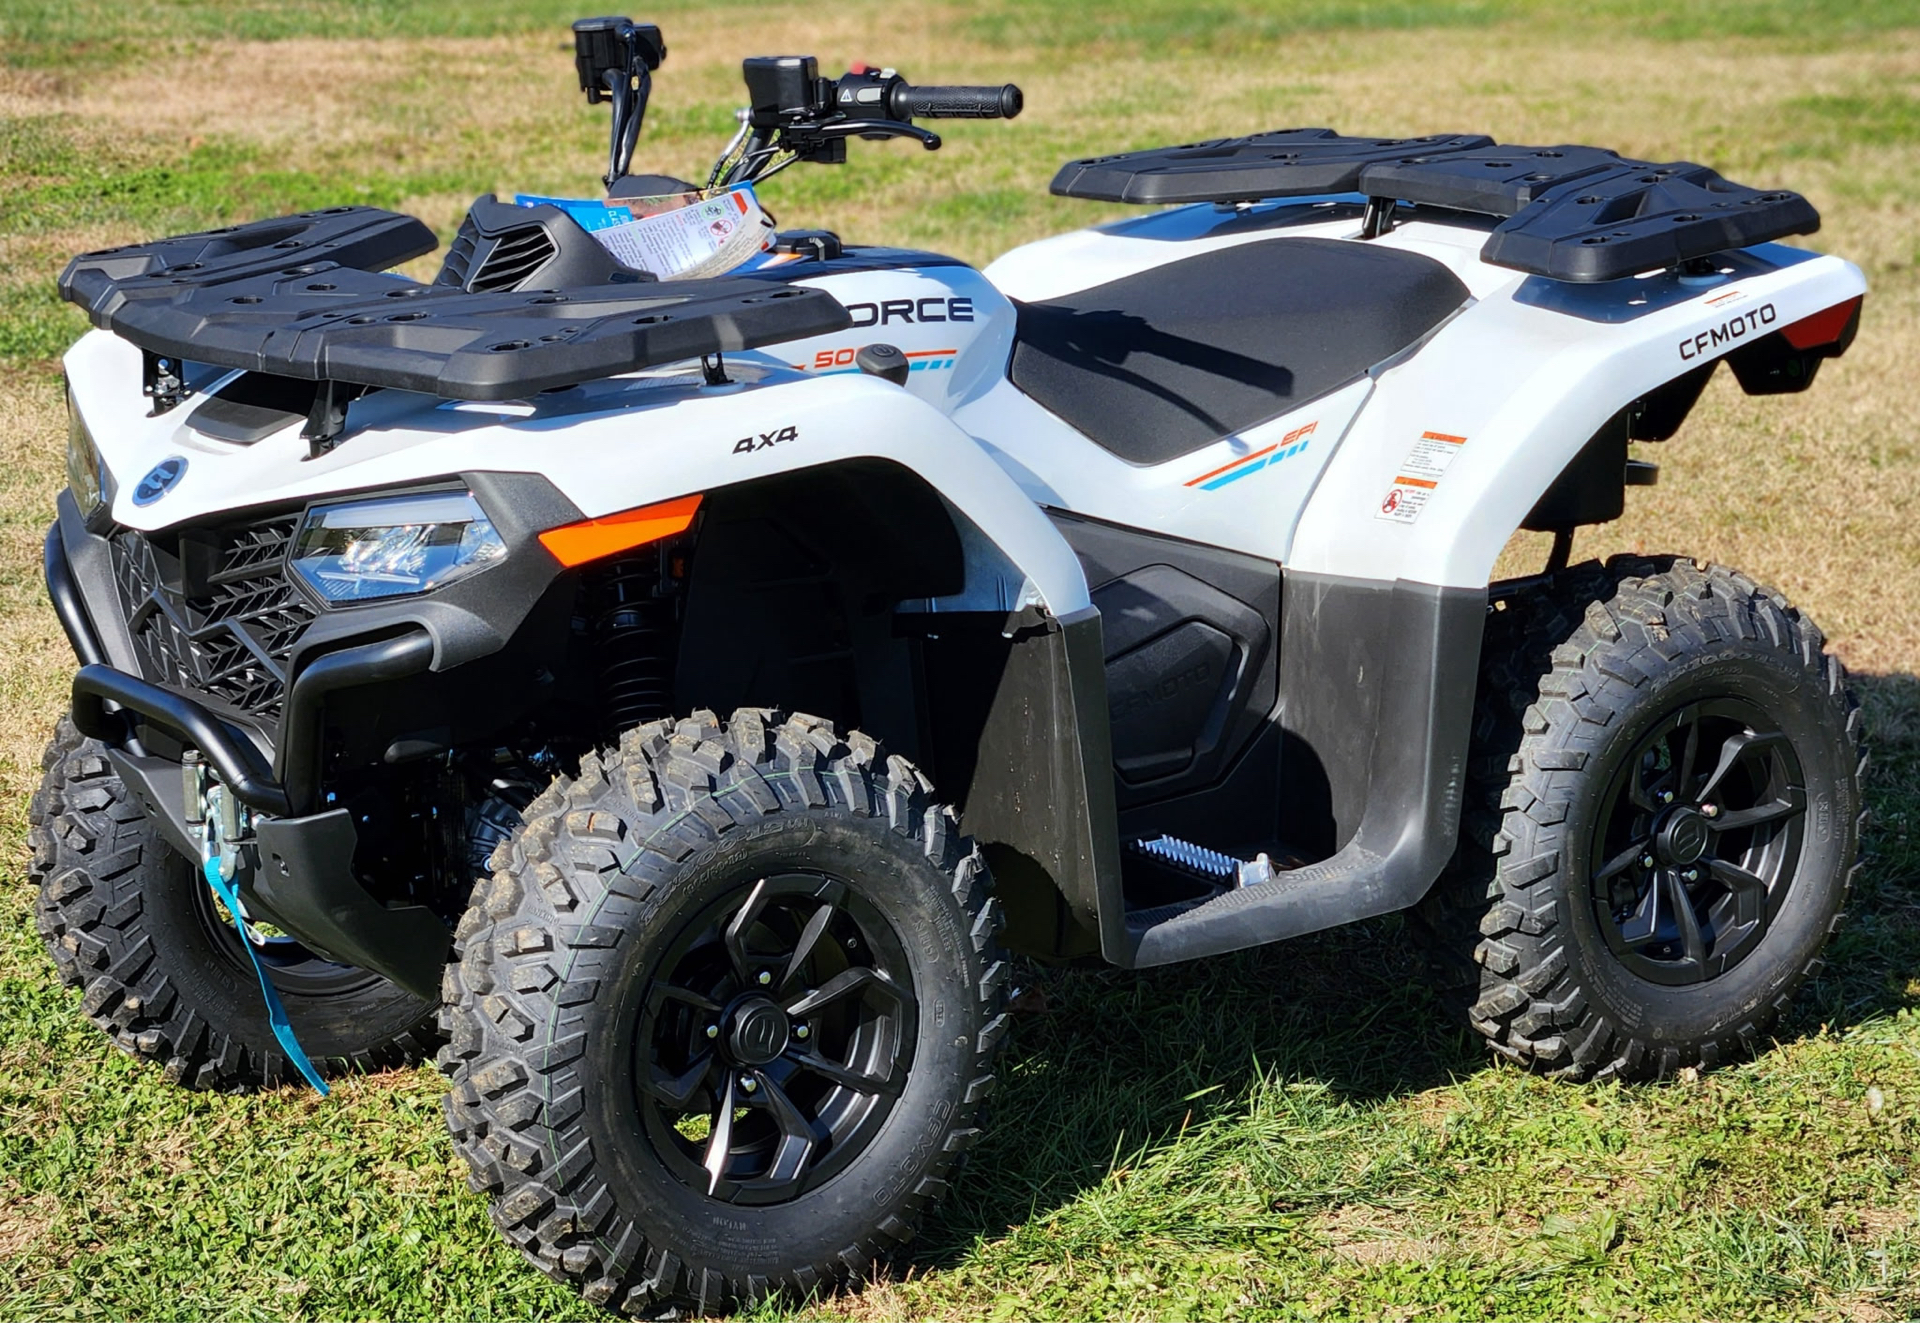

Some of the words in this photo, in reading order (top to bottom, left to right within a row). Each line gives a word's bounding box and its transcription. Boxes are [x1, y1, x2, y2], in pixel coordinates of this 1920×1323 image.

[1678, 303, 1777, 361] CFMOTO
[814, 347, 863, 369] 50
[1280, 420, 1319, 447] EFI
[872, 1099, 952, 1208] CFMOTO
